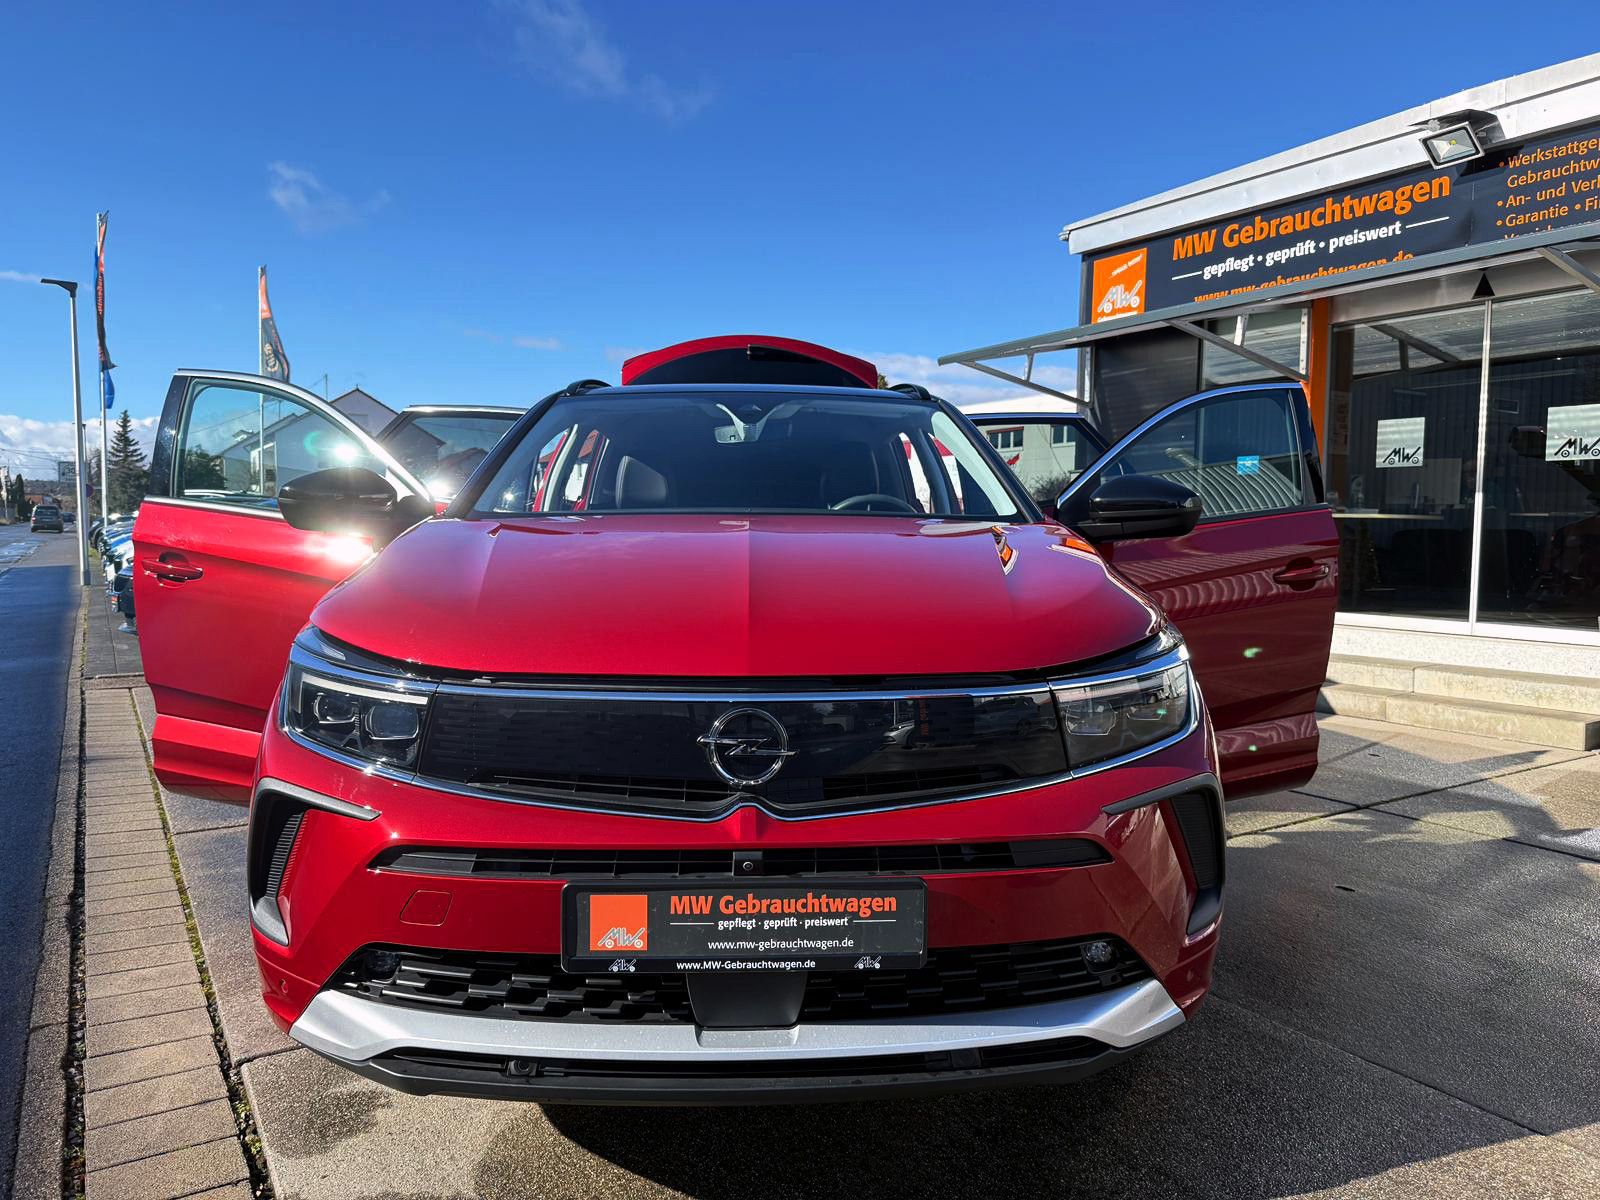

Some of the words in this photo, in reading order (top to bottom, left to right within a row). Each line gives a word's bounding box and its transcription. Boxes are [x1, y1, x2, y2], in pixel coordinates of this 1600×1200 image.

[1508, 137, 1600, 169] Werkstattge
[1505, 194, 1531, 208] An-
[1536, 181, 1566, 201] und
[1172, 229, 1218, 261] MW
[1223, 175, 1450, 248] Gebrauchtwagen
[1505, 203, 1568, 227] Garantie
[1585, 195, 1600, 212] Fi
[1203, 254, 1254, 280] gepflegt
[1265, 239, 1316, 266] geprüft
[1329, 220, 1401, 253] preiswert
[670, 895, 713, 915] MW
[720, 892, 897, 918] Gebrauchtwagen
[718, 918, 756, 930] gepflegt
[763, 917, 797, 930] geprüft
[805, 917, 848, 930] preiswert
[708, 937, 854, 951] www.mw-gebrauchtwagen.de
[676, 960, 816, 971] www.MW-Gebrauchtwagen.de
